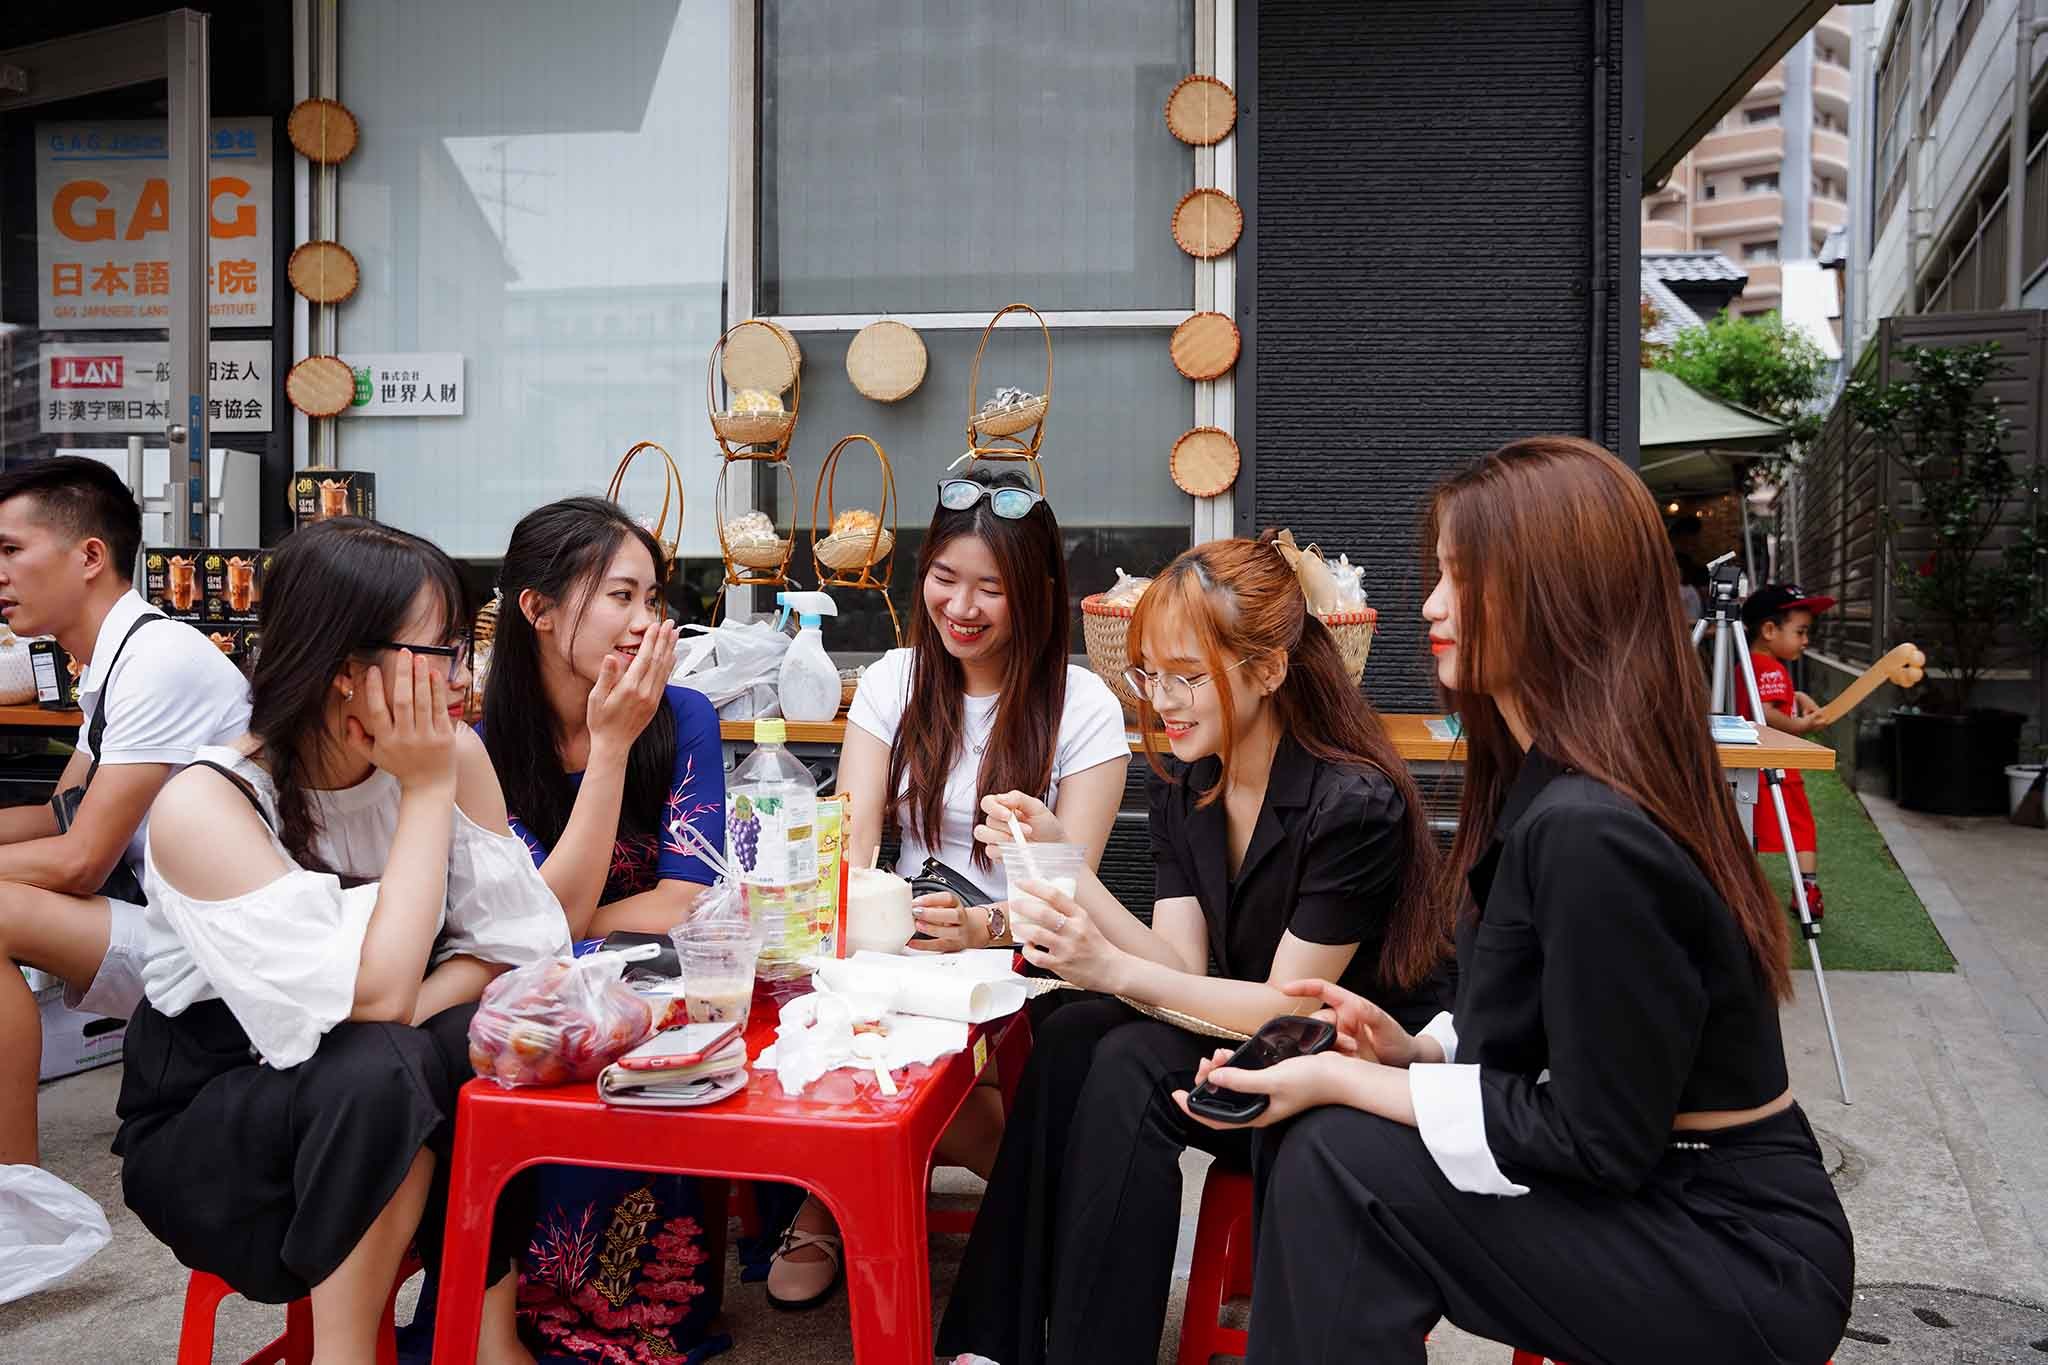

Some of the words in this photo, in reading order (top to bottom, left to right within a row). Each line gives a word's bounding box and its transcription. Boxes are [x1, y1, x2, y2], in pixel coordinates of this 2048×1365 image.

[52, 258, 257, 297] 日本語院
[59, 361, 118, 384] JLAN
[135, 360, 261, 382] 一般団法人
[381, 383, 457, 403] 世界人財
